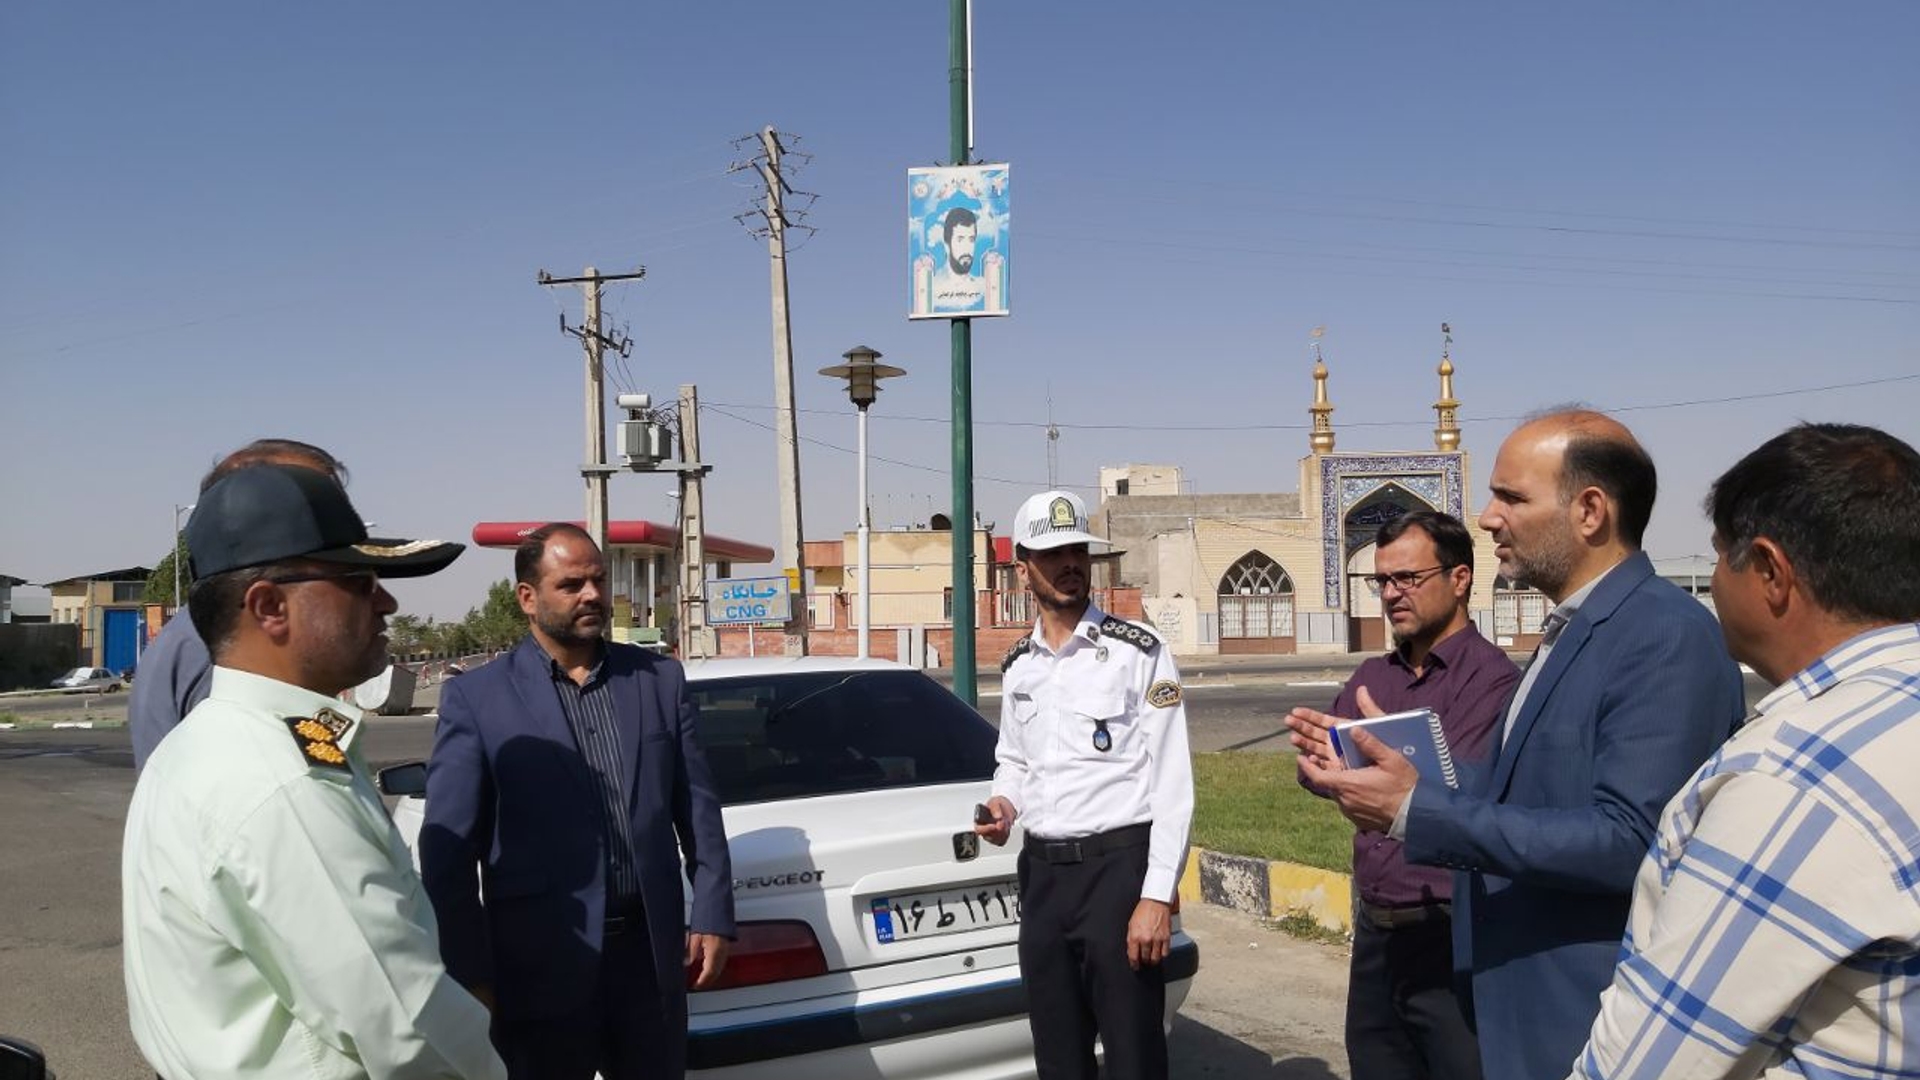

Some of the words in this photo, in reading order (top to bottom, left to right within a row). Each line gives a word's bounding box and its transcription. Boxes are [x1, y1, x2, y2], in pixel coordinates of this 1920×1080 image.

[722, 584, 778, 602] جایگاه
[726, 604, 766, 619] CNG
[732, 870, 825, 890] PEUGEOT
